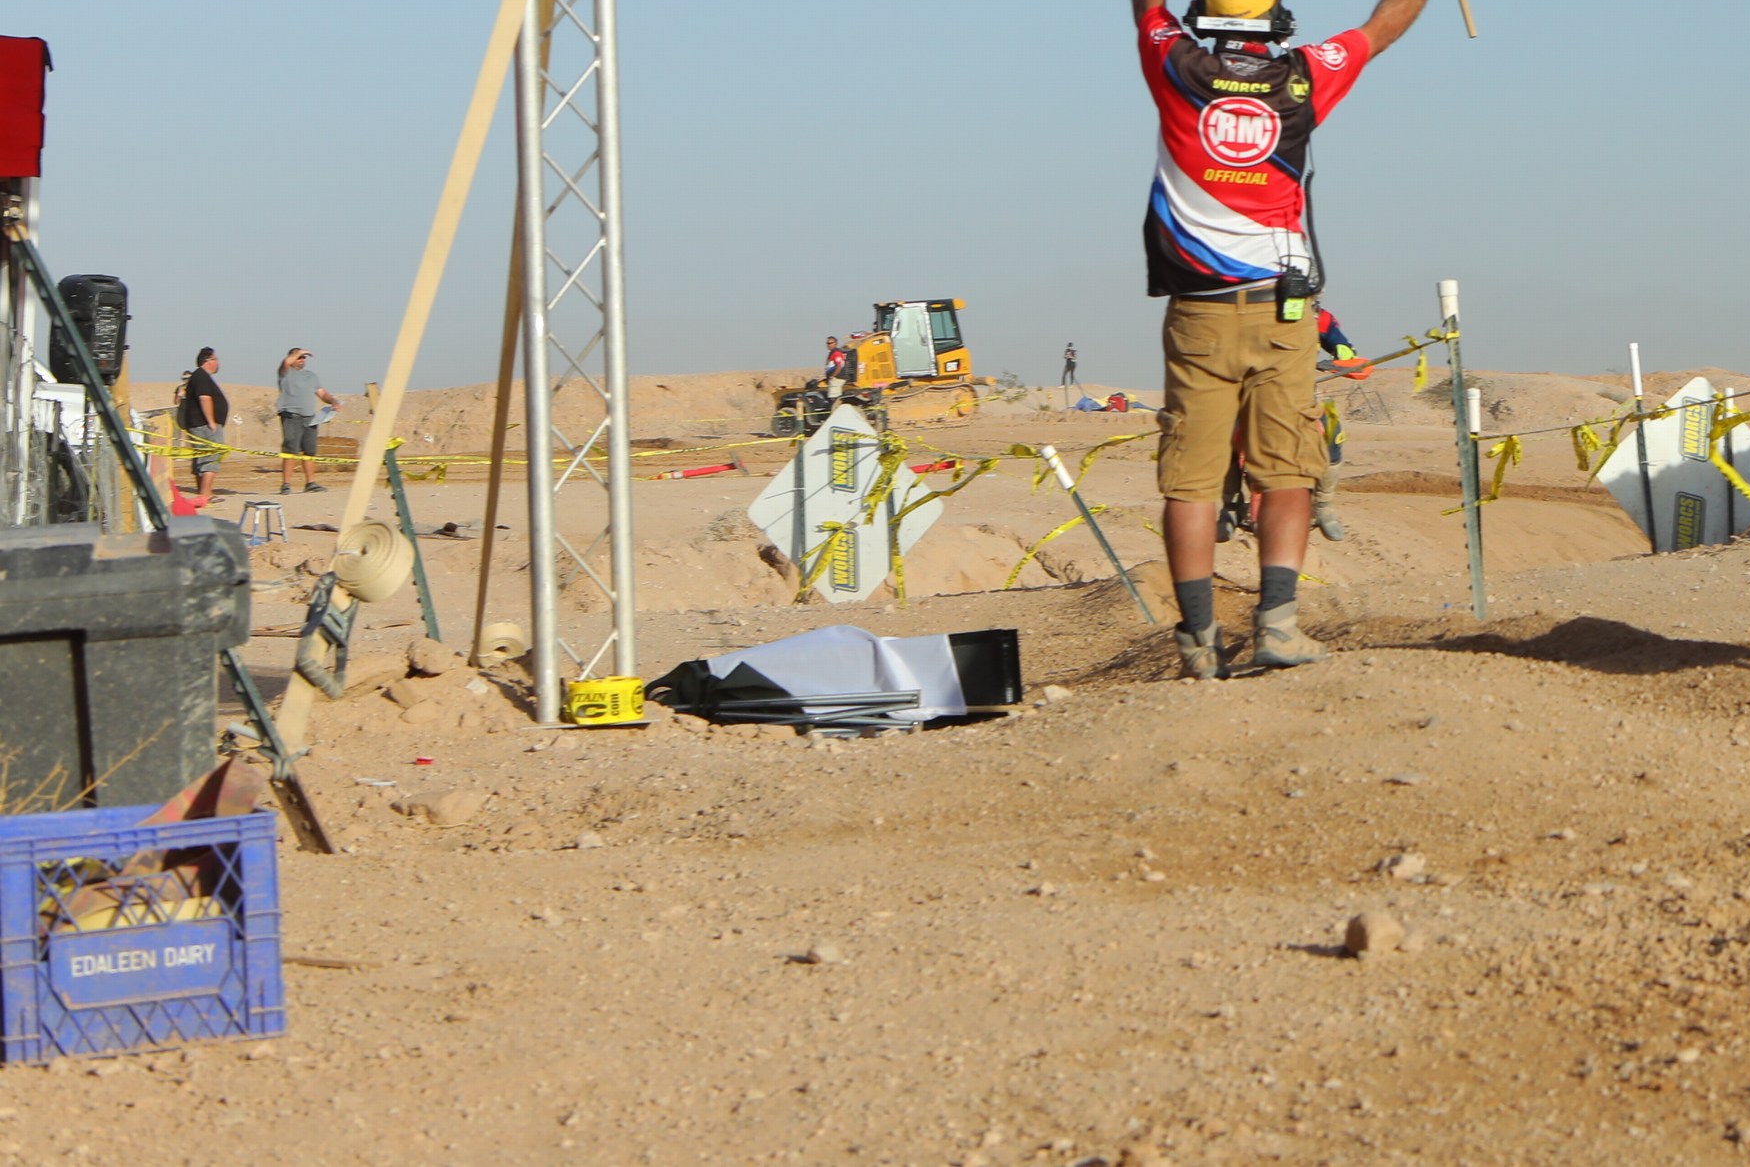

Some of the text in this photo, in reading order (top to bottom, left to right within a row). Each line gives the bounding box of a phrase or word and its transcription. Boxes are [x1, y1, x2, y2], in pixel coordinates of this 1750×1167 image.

[1212, 78, 1271, 93] WORCS
[1214, 108, 1268, 145] RM
[1203, 168, 1269, 186] OFFICIAL
[1683, 402, 1701, 454] WORCS
[1678, 497, 1695, 548] WORCS
[70, 943, 217, 979] EDALEEN DAIRY
